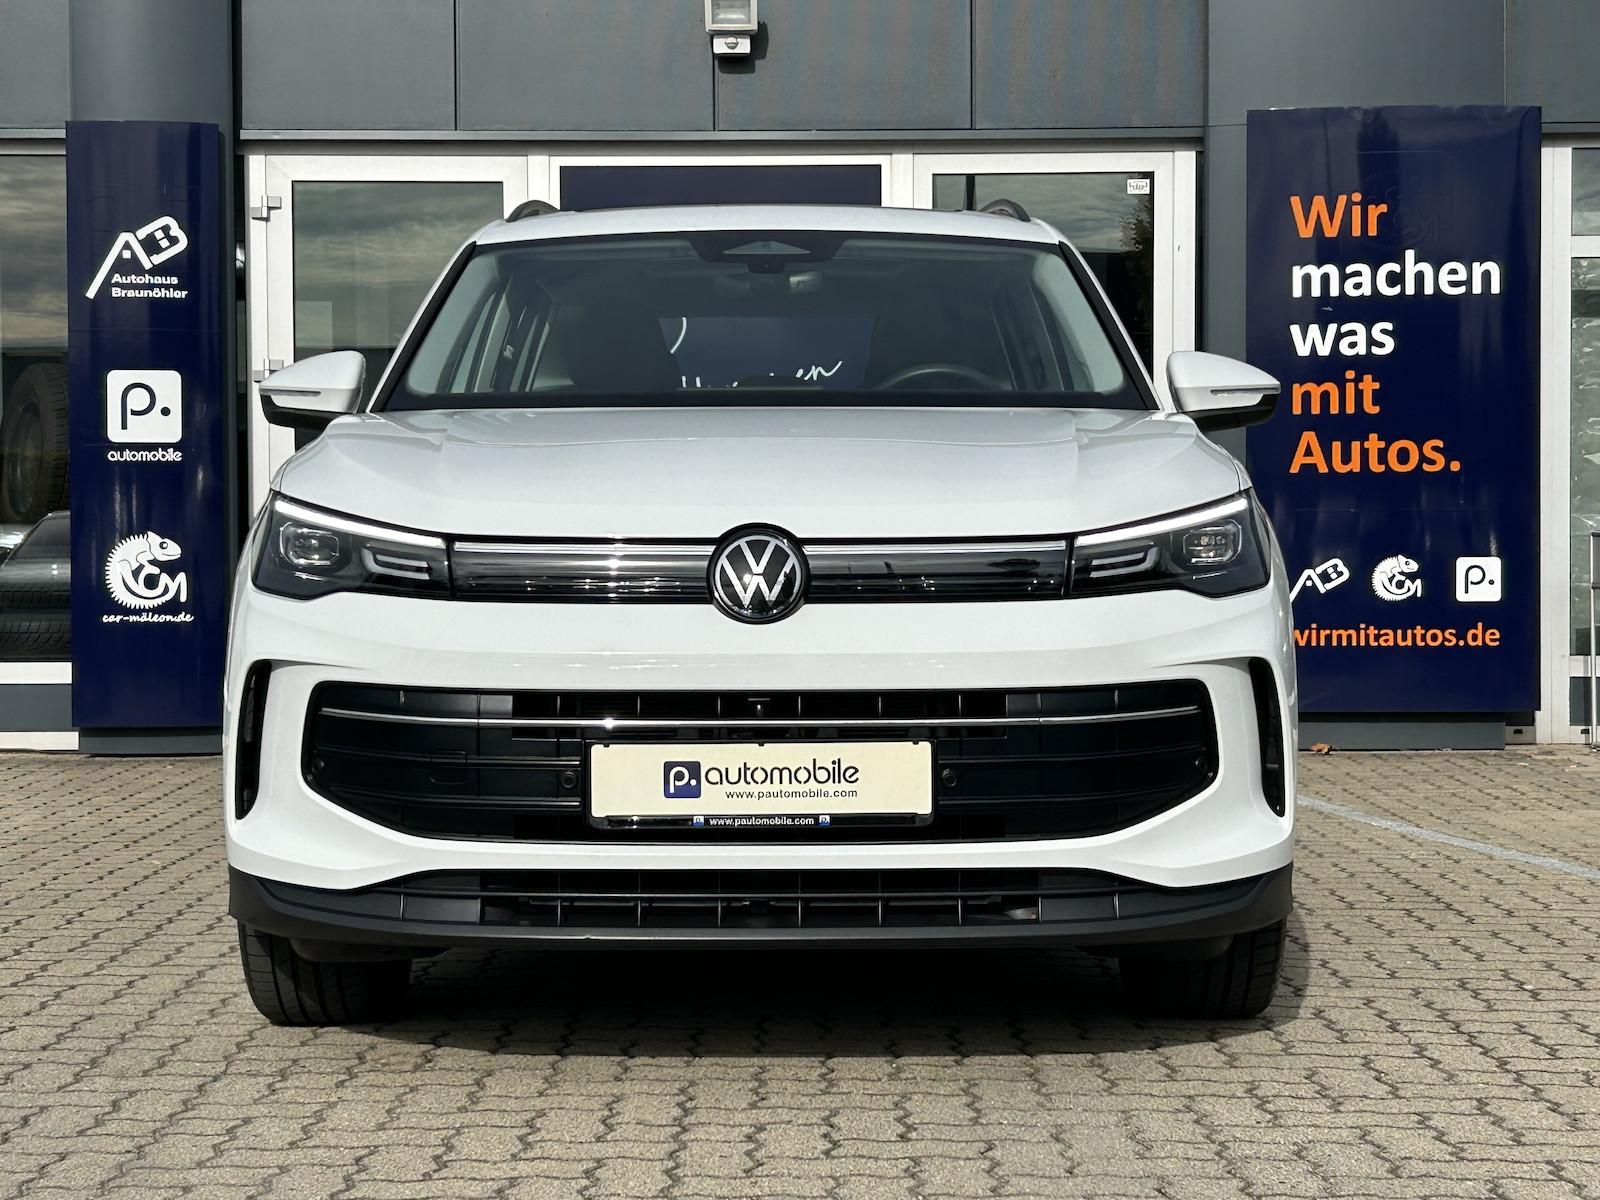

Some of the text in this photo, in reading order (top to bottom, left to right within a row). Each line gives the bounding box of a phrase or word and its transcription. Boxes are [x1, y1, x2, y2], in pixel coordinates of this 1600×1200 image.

[1290, 192, 1388, 238] Wir
[111, 273, 179, 284] Autohaus
[1292, 249, 1500, 298] machen
[111, 287, 188, 299] Braunöhler
[1289, 321, 1395, 357] was
[1292, 370, 1380, 415] mit
[107, 448, 182, 462] automobile
[1289, 431, 1461, 474] Autos.
[717, 536, 798, 610] VW
[704, 758, 860, 785] automobile
[725, 789, 858, 800] www.pautomobile.com
[709, 816, 815, 827] www.pautomobile.com
